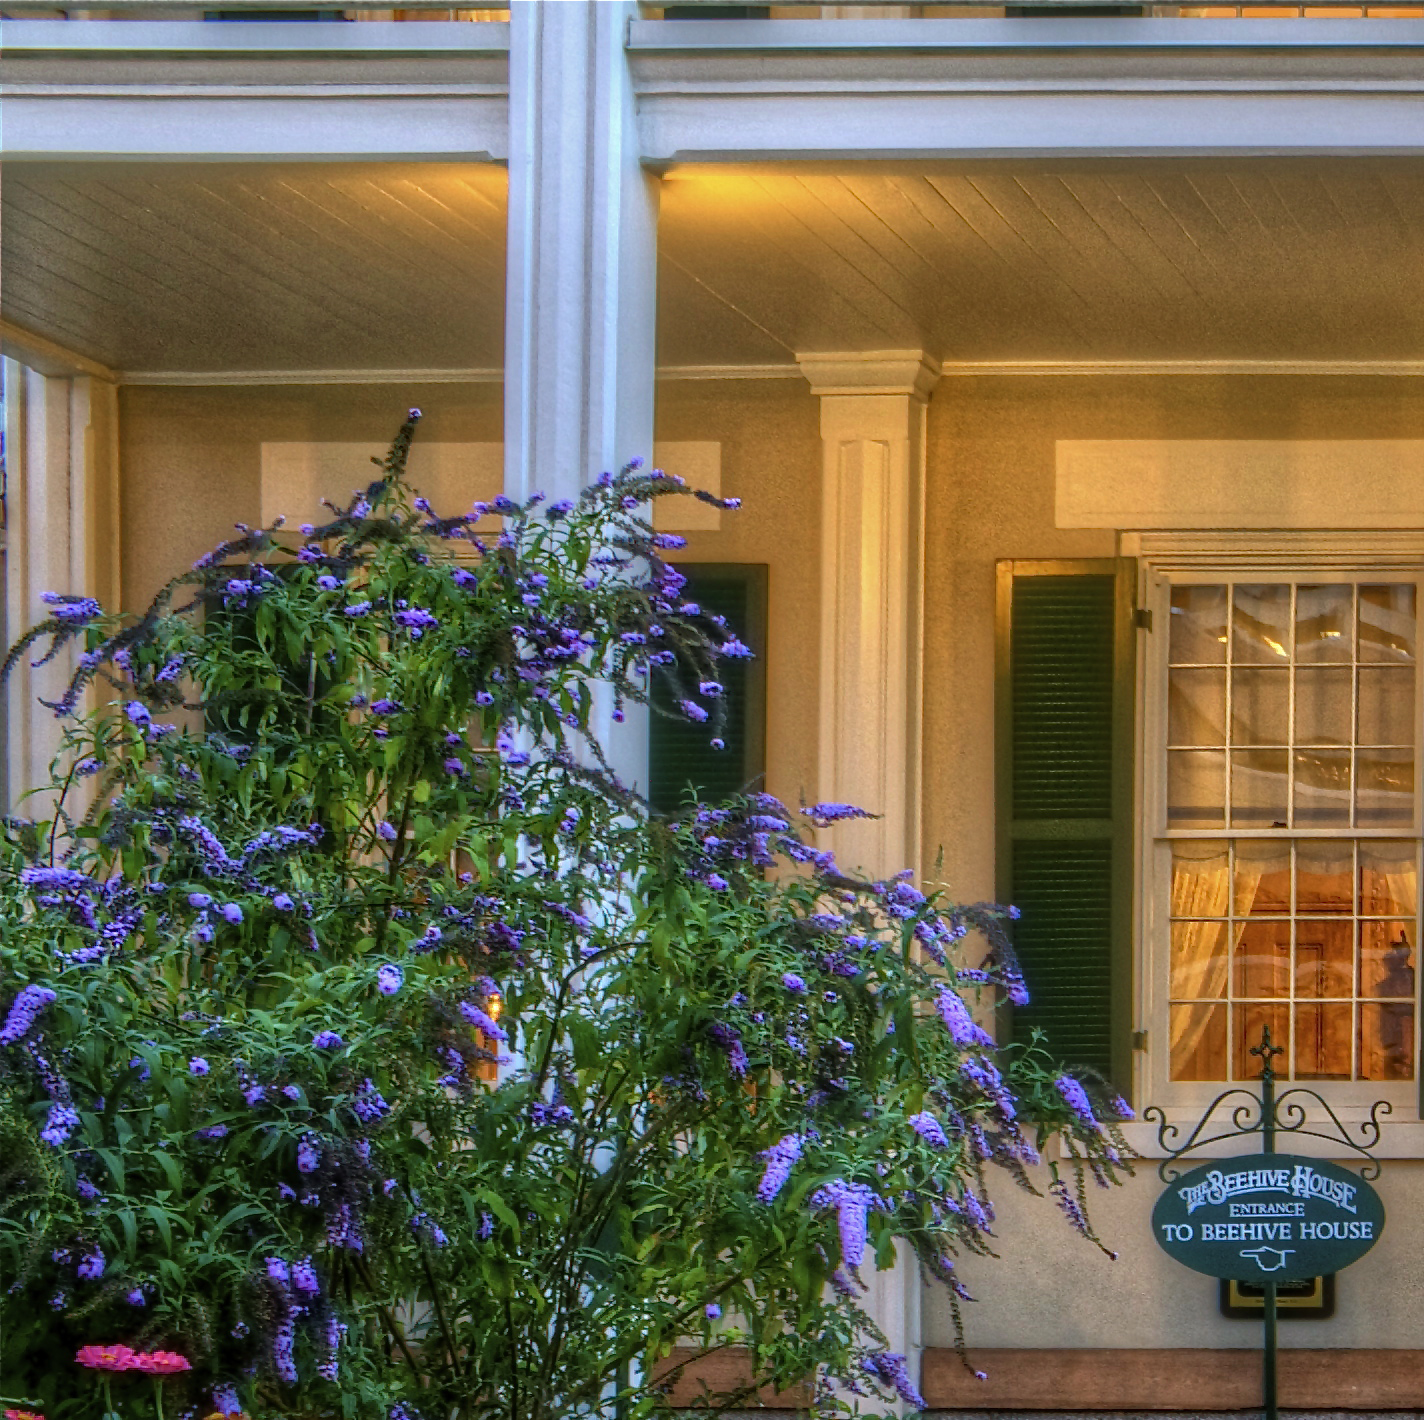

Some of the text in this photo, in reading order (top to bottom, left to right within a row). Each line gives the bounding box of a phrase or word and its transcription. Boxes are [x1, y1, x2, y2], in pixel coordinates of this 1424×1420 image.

[1178, 1165, 1357, 1214] THE BEEHIVE HOUSE
[1229, 1203, 1305, 1217] ENTRANCE
[1162, 1222, 1373, 1241] TO BEEHIVE HOUSE
